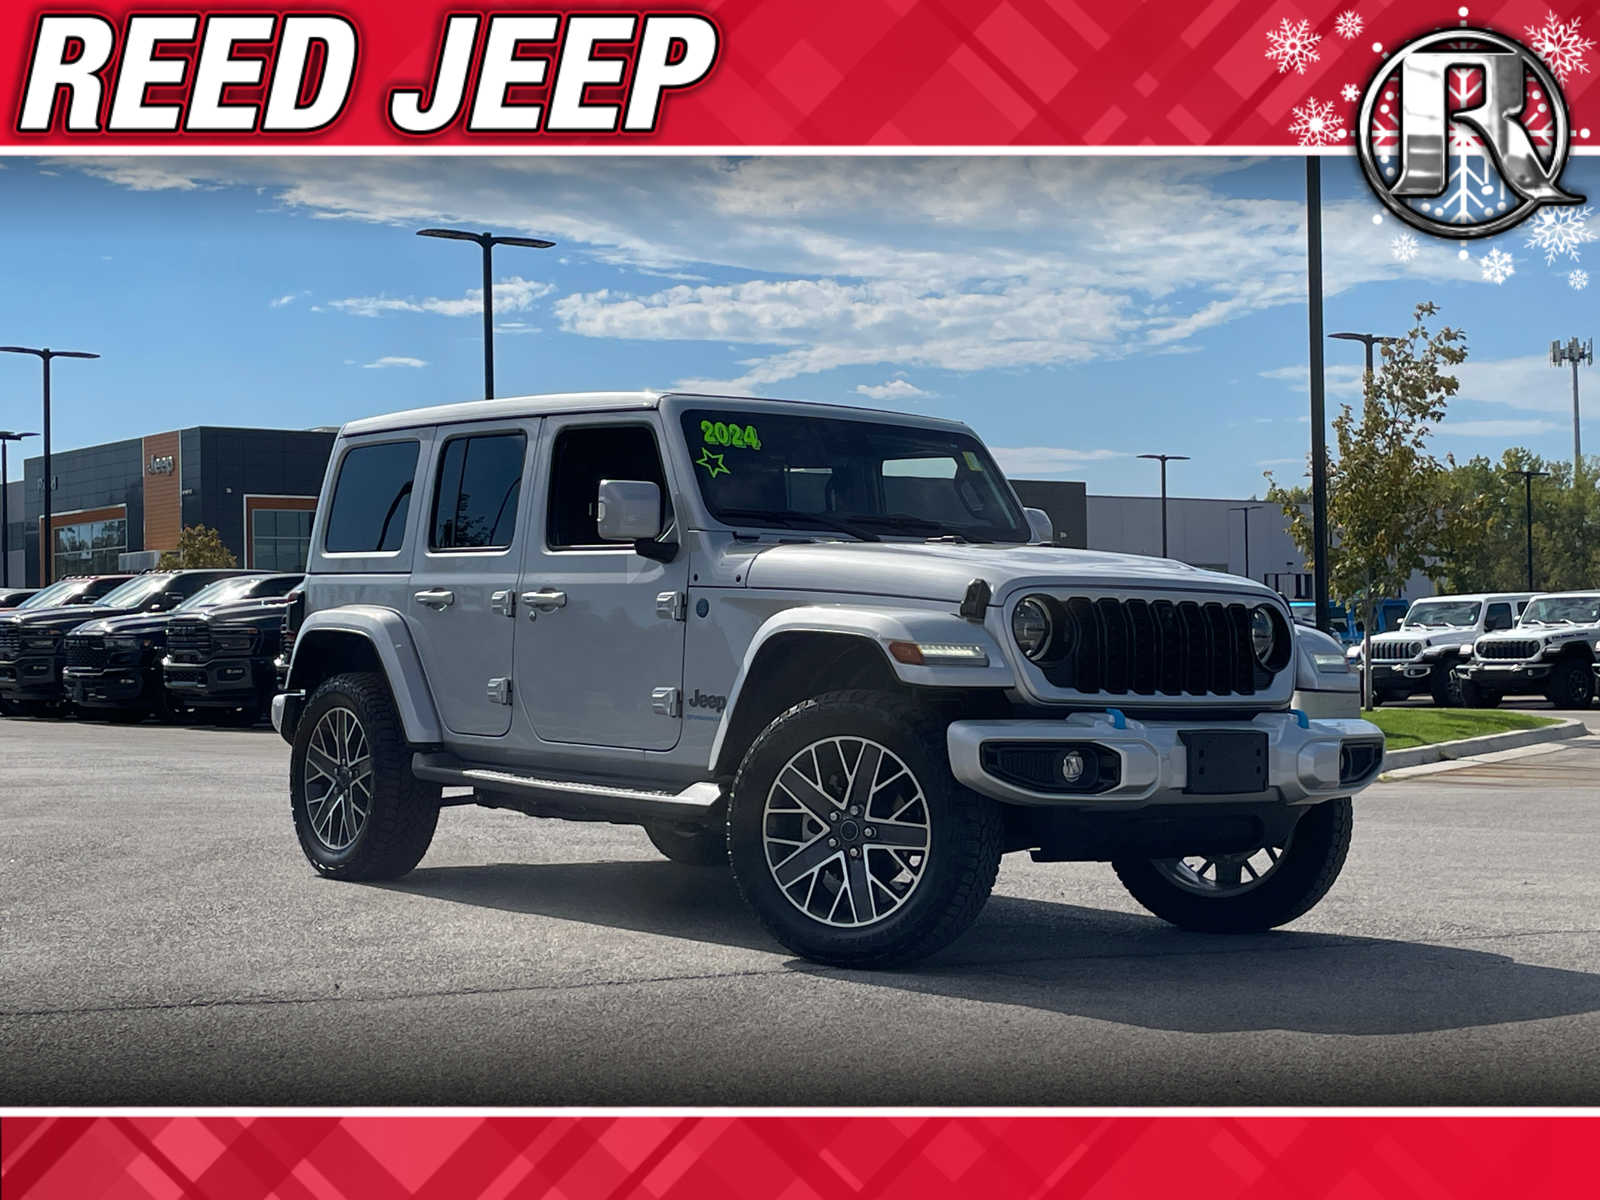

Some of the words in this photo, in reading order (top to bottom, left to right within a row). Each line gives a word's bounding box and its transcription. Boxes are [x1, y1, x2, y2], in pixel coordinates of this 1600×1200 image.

[701, 420, 762, 450] 2024
[146, 454, 174, 476] Jeep
[689, 689, 727, 713] Jeep
